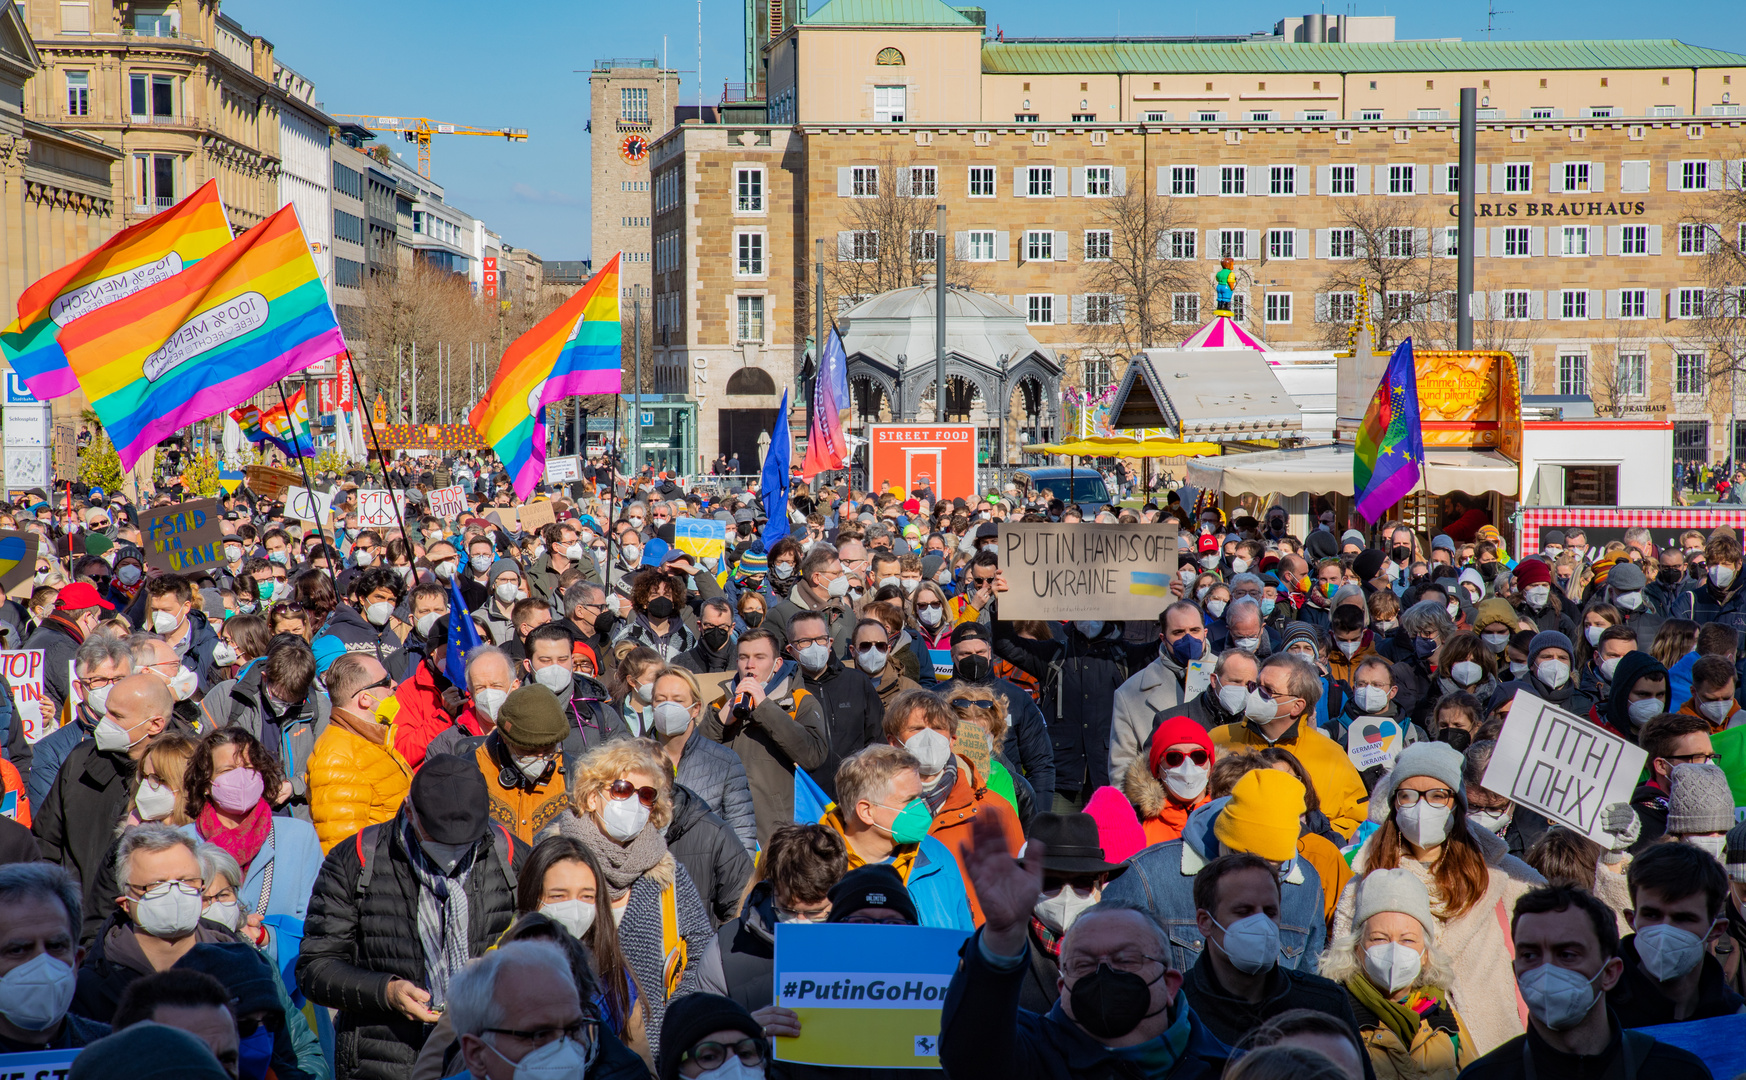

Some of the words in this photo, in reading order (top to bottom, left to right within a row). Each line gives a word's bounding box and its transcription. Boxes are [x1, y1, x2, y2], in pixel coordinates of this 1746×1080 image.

[1449, 203, 1518, 217] CRLS
[1526, 201, 1645, 216] BRAUHAUS
[694, 355, 708, 411] ONLY
[1458, 373, 1481, 390] frisch
[1424, 390, 1441, 400] und
[879, 431, 930, 440] STREET
[936, 431, 968, 440] FOOD
[360, 493, 402, 505] STOP
[430, 486, 463, 505] STOP
[431, 500, 463, 518] PUTIN
[148, 509, 206, 540] #STAND
[154, 536, 182, 554] WITH
[1006, 532, 1080, 567] PUTIN,
[1083, 533, 1142, 563] HANDS
[1144, 534, 1176, 562] OFF
[168, 540, 224, 571] UKRAINE
[1032, 569, 1119, 597] UKRAINE
[1, 651, 41, 678] TOP
[1351, 741, 1382, 754] GERMANY
[1541, 717, 1610, 779] ПТН
[1360, 754, 1387, 766] UKRAINE
[1525, 760, 1595, 827] ПНХ
